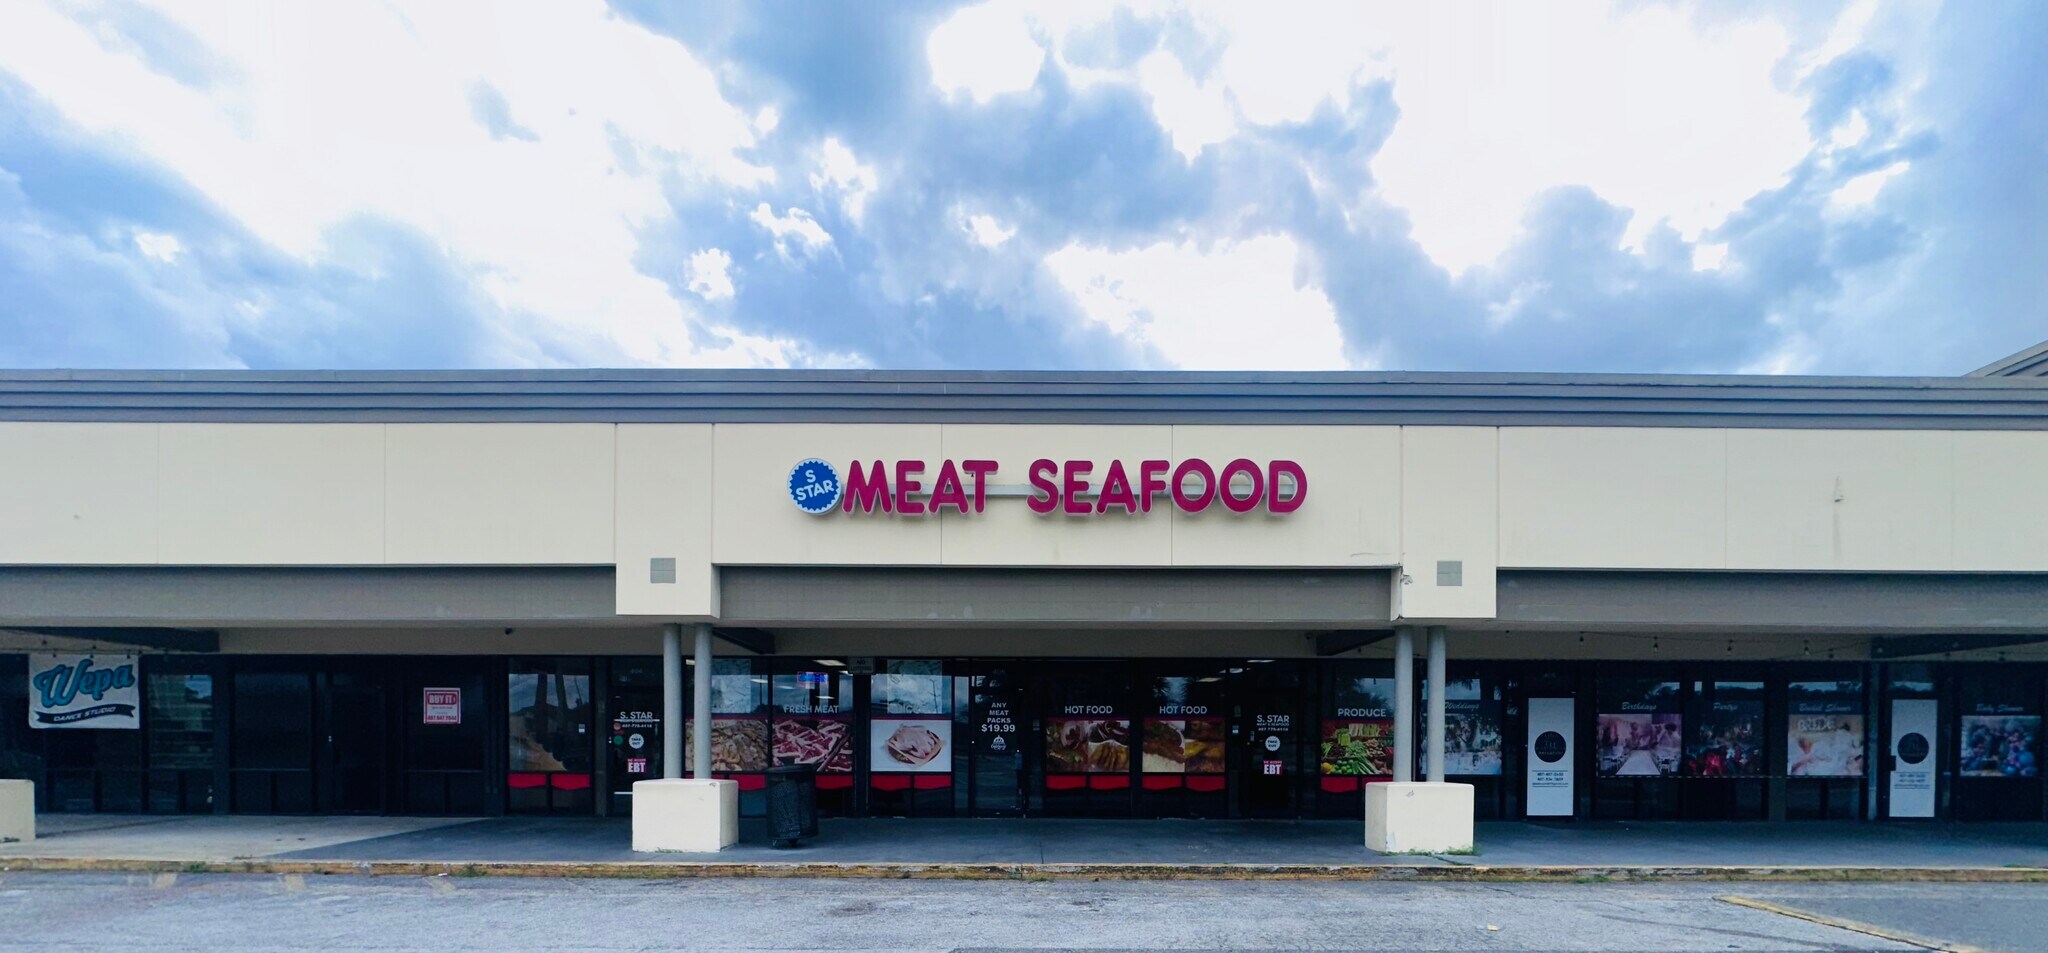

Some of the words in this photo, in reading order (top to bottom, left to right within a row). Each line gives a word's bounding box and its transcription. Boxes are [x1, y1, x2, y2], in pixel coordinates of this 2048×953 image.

[804, 469, 817, 484] S
[795, 479, 835, 501] STAR
[842, 459, 999, 514] MEAT
[1026, 458, 1308, 515] SEAFOOD
[33, 658, 136, 708] Wepa
[784, 704, 813, 713] FRESH
[814, 704, 840, 713] MEAT
[1064, 705, 1084, 714] HOT
[1086, 705, 1113, 714] FOOD
[1159, 705, 1179, 715] HOT
[1180, 705, 1207, 715] FOOD
[1621, 701, 1657, 711] Birthdays
[52, 711, 82, 722] DANCE
[83, 706, 117, 717] STUDIO
[620, 711, 629, 720] S.
[630, 711, 653, 720] STAR
[1337, 708, 1387, 717] PRODUCE
[1256, 714, 1265, 723] S.
[1267, 714, 1290, 723] STAR
[981, 723, 1016, 733] $19.99
[628, 762, 646, 773] EBT
[1264, 764, 1282, 775] EBT
